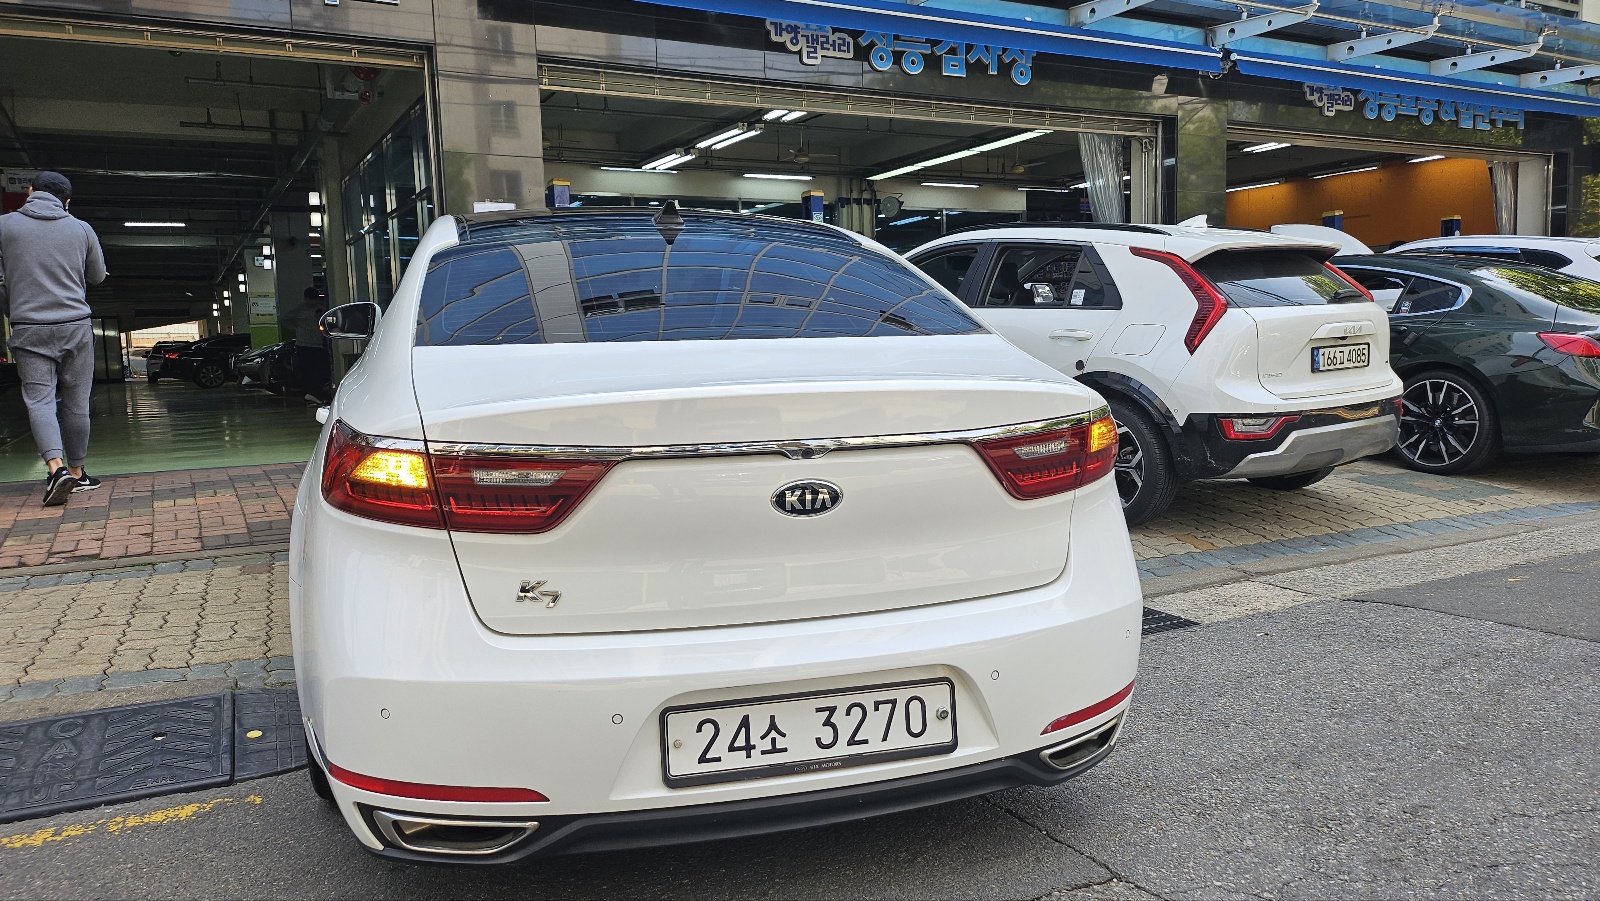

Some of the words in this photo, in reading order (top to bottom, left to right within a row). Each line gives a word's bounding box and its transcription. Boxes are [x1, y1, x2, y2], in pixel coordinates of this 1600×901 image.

[769, 21, 801, 47] 가양
[800, 33, 851, 60] 갤러리
[1323, 93, 1353, 112] 갤러리
[1346, 347, 1367, 364] 4085
[785, 488, 834, 511] KIA
[515, 579, 562, 609] K7
[696, 714, 788, 764] 24소
[815, 695, 928, 750] 3270
